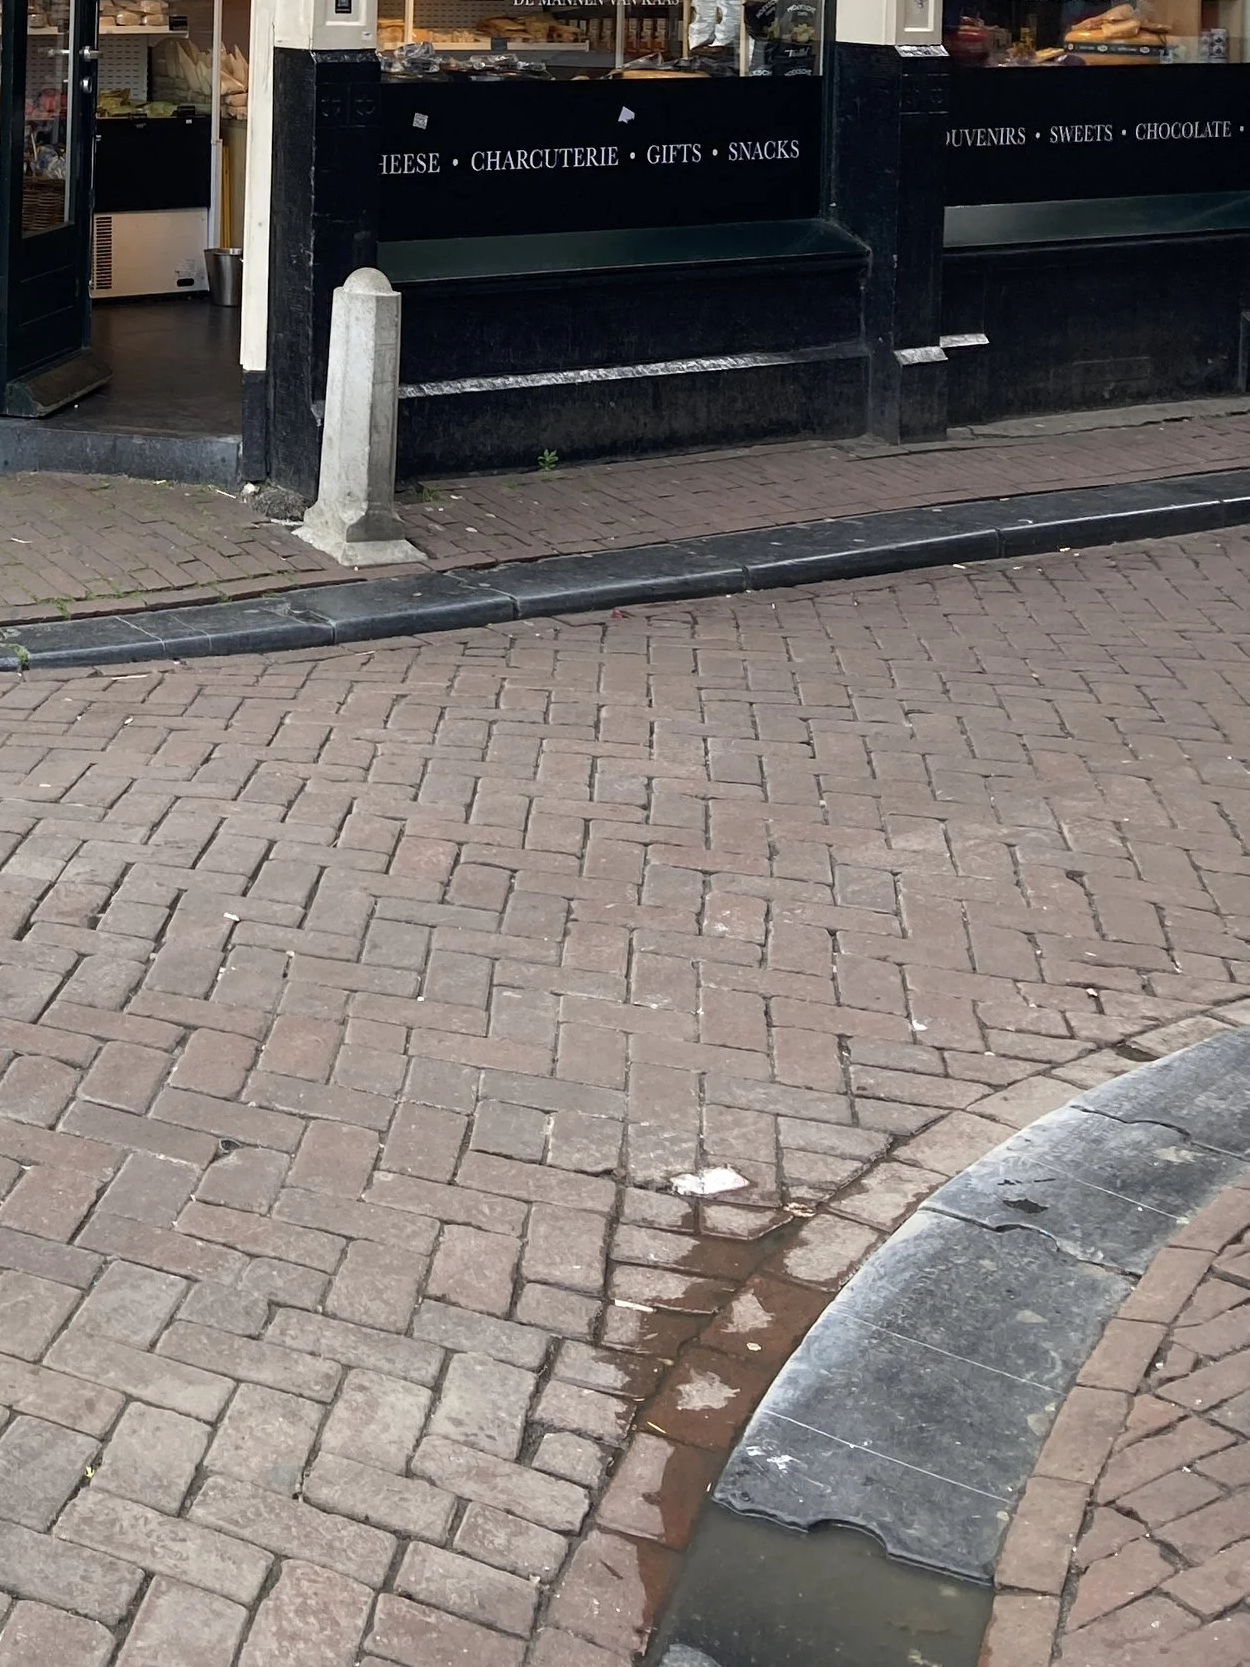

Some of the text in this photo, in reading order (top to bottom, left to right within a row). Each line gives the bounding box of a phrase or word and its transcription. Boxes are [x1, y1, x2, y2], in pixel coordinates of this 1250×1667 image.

[945, 121, 1232, 147] UVENIRS SWEETS CHOCOLATE
[379, 139, 800, 176] HEESE CHARCUTERIE GIFTS SNACKS
